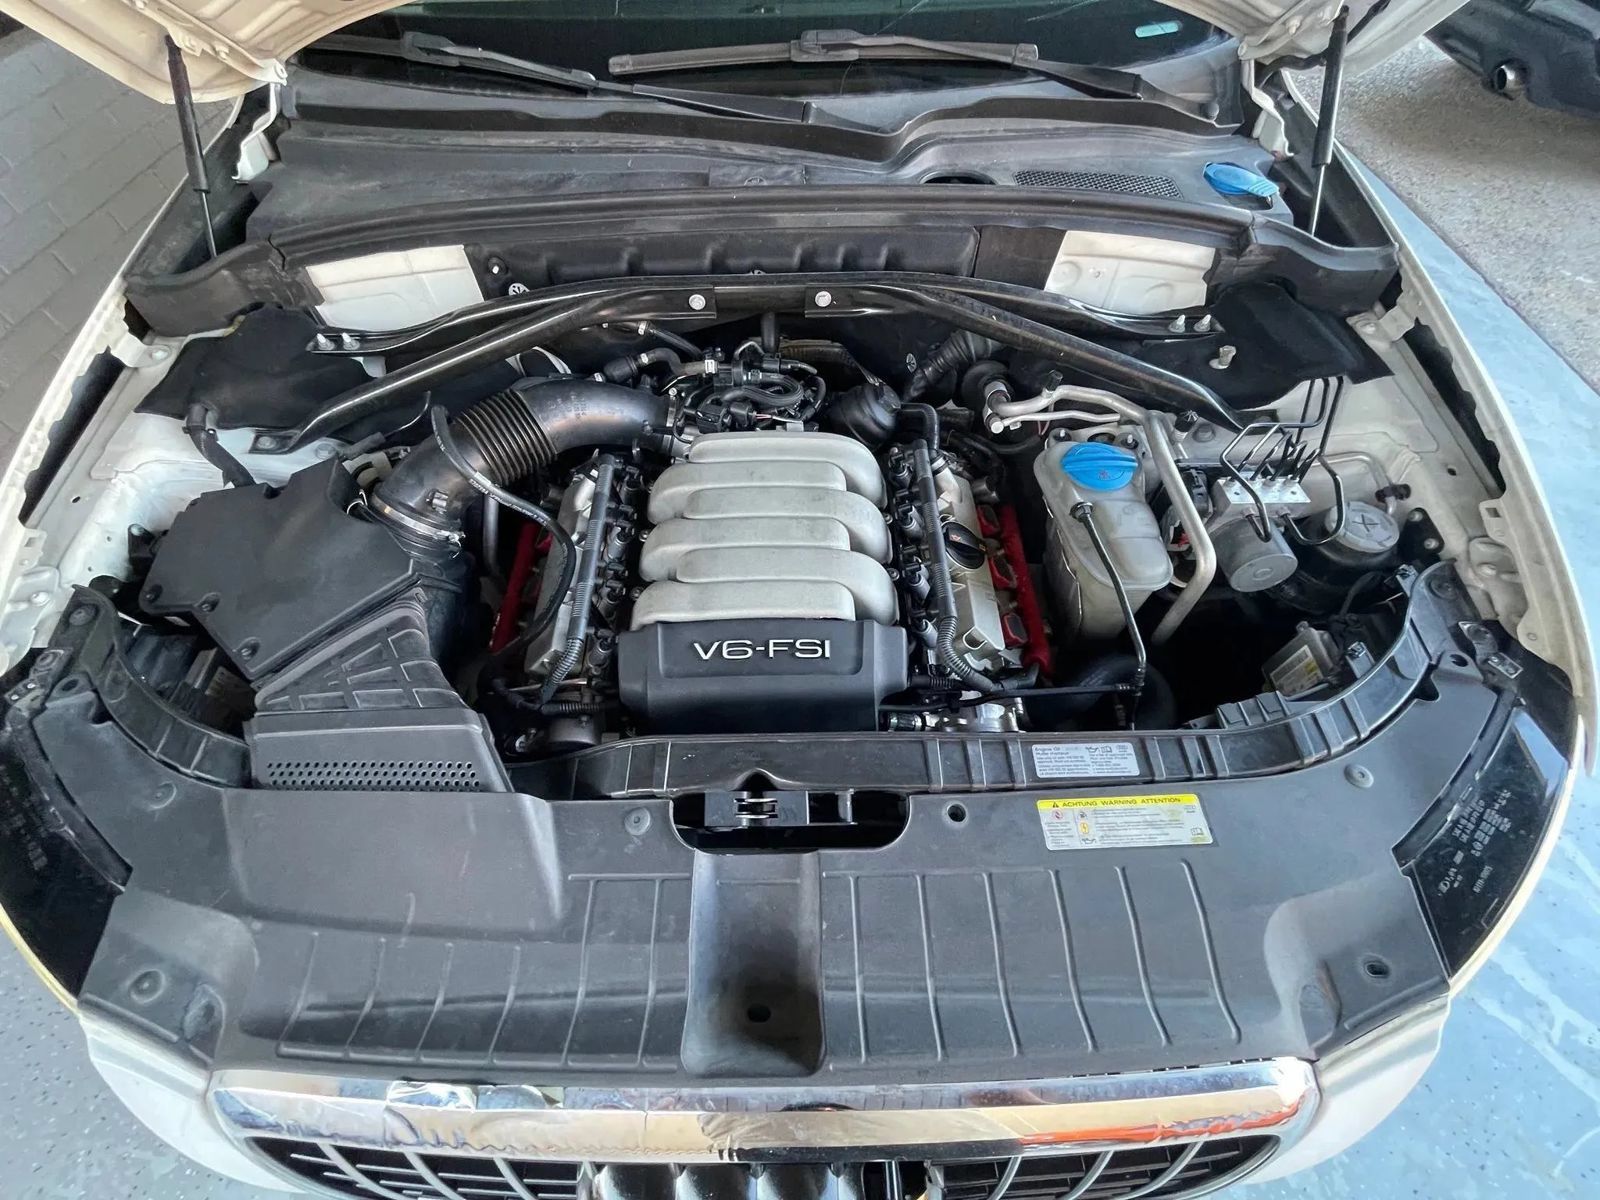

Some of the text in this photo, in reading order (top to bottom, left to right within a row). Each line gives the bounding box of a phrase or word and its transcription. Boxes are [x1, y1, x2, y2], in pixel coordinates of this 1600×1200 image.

[693, 638, 831, 660] V6-FSI
[1101, 798, 1138, 806] WARNING
[1141, 797, 1181, 805] ATTENTION
